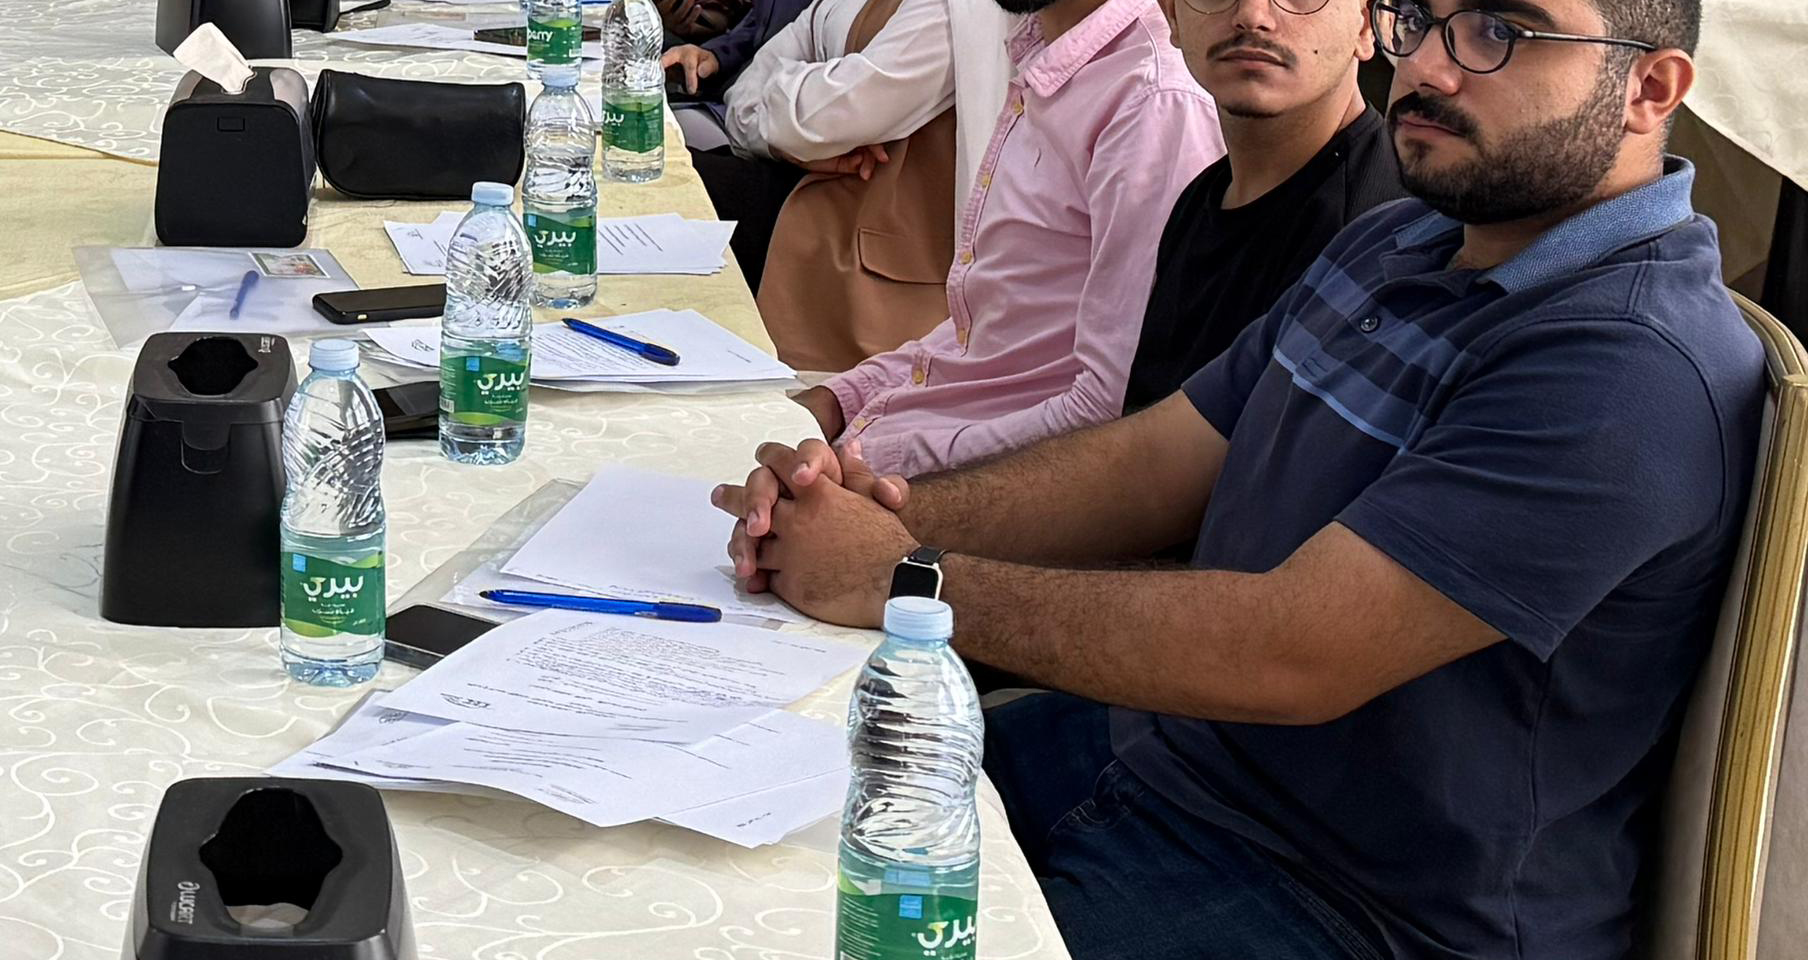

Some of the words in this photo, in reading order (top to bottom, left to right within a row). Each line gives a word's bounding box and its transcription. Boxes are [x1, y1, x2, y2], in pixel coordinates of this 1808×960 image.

[534, 230, 577, 248] بيري
[476, 372, 525, 396] بيري
[302, 575, 364, 602] بيري
